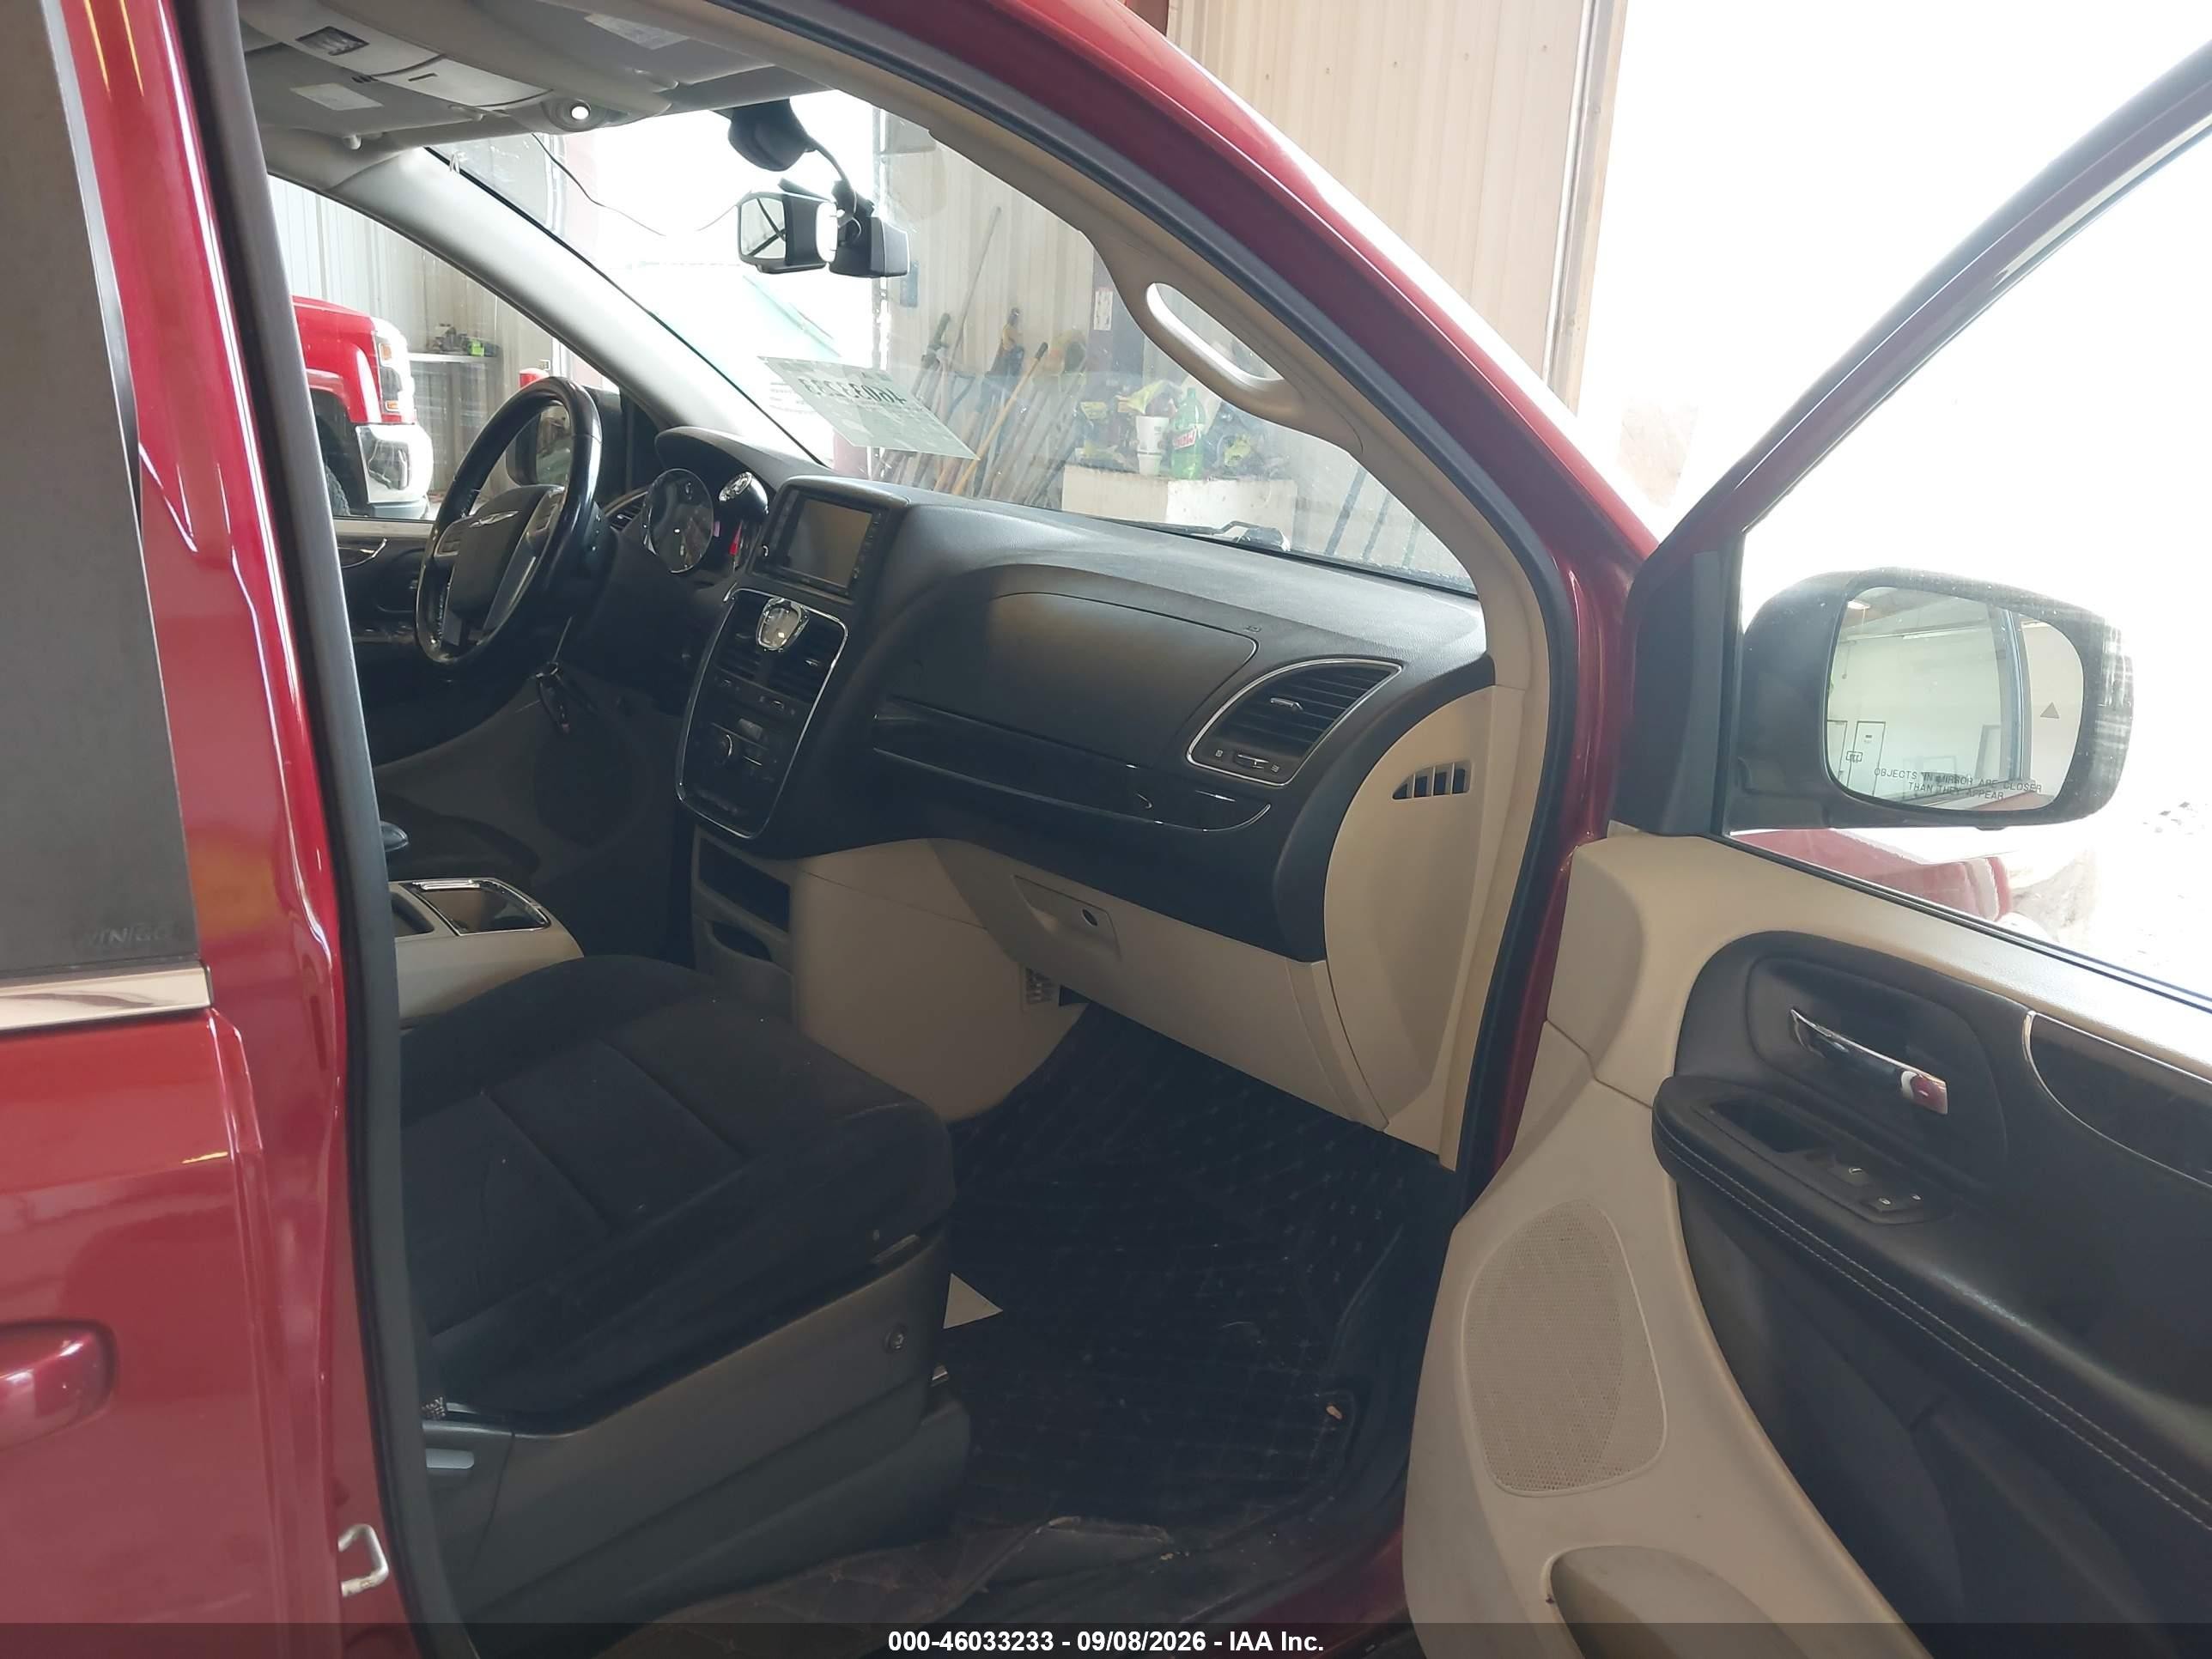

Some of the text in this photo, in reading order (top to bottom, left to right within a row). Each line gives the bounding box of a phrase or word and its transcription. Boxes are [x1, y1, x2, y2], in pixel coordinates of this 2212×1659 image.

[1874, 768, 2043, 793] OBJECTS IN MIRROR ARE CLOSER
[1908, 781, 2004, 800] THAN THEY APPEAR
